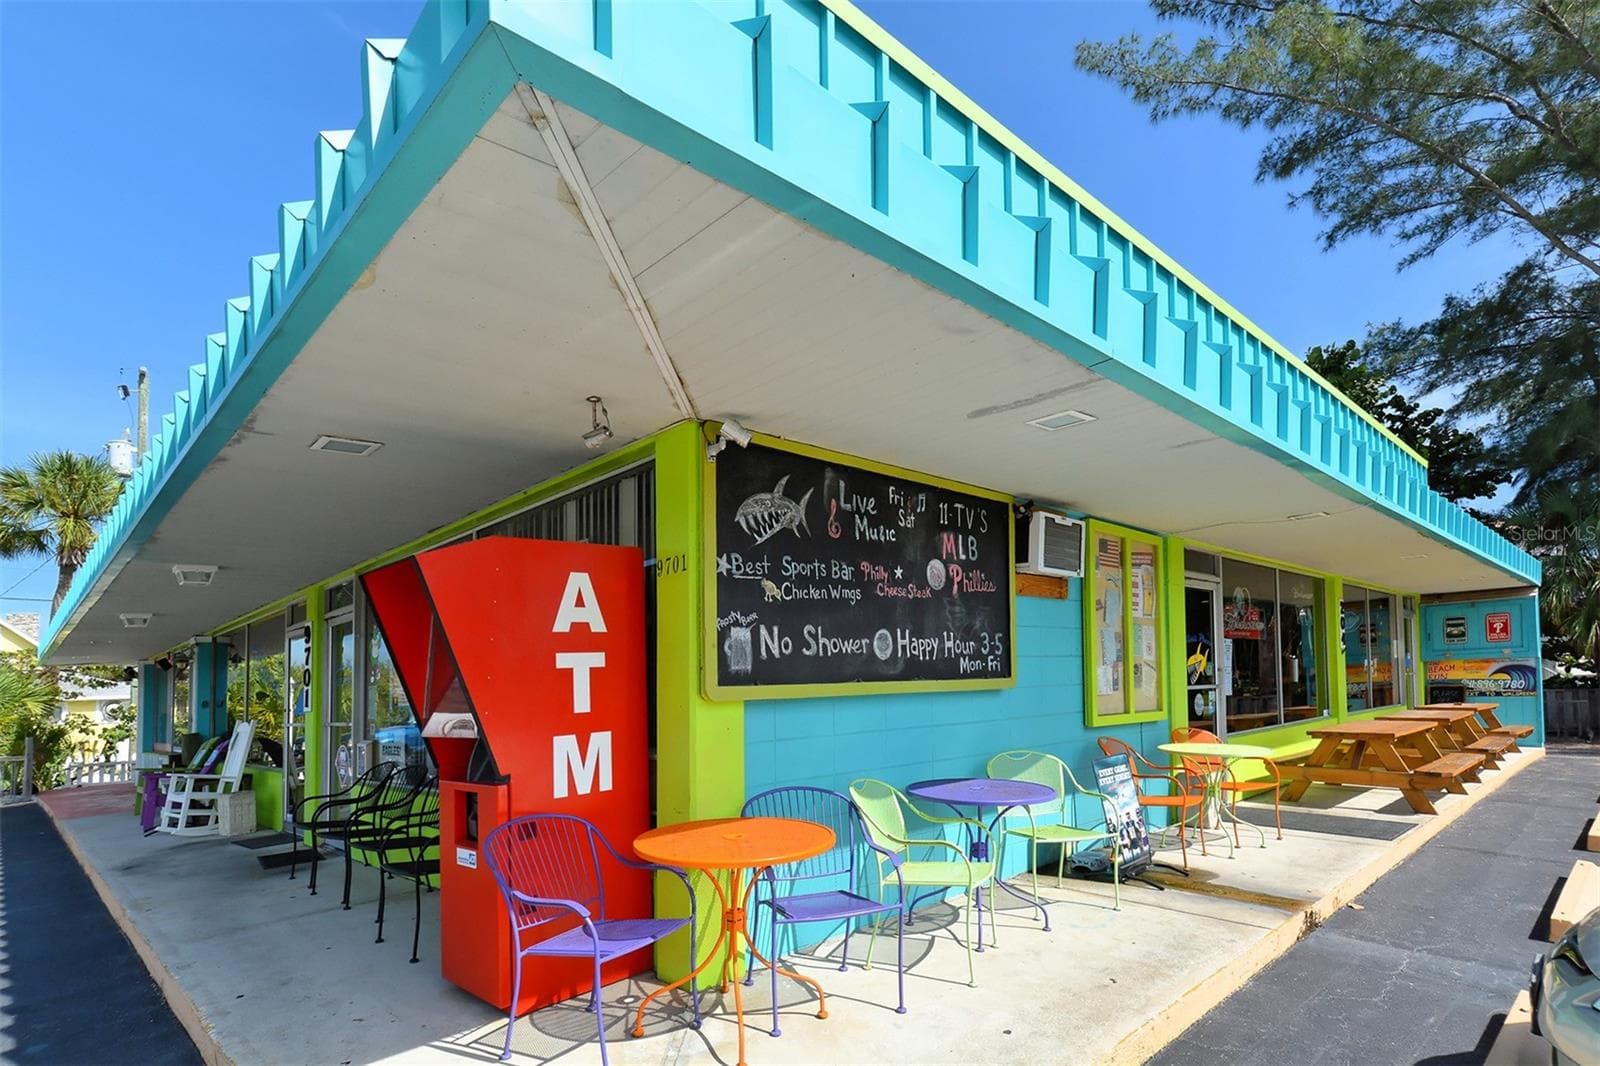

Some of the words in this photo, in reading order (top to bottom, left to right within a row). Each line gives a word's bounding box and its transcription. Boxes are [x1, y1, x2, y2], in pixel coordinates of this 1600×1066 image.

[839, 479, 878, 515] Live
[889, 486, 904, 507] Fri
[855, 514, 897, 543] Music
[898, 509, 915, 528] Sat
[942, 532, 978, 561] MLB
[656, 554, 687, 577] 9701
[731, 552, 771, 575] Best
[781, 555, 827, 580] Sports
[860, 561, 890, 583] Philly
[781, 582, 828, 600] Chicken
[828, 584, 862, 605] Wings
[948, 563, 997, 598] Phillies
[760, 624, 793, 659] No
[802, 624, 870, 656] Shower
[897, 627, 939, 661] Happy
[943, 631, 975, 658] Hour
[303, 625, 311, 708] 9701
[1428, 664, 1456, 673] BEACH
[552, 571, 613, 799] ATM
